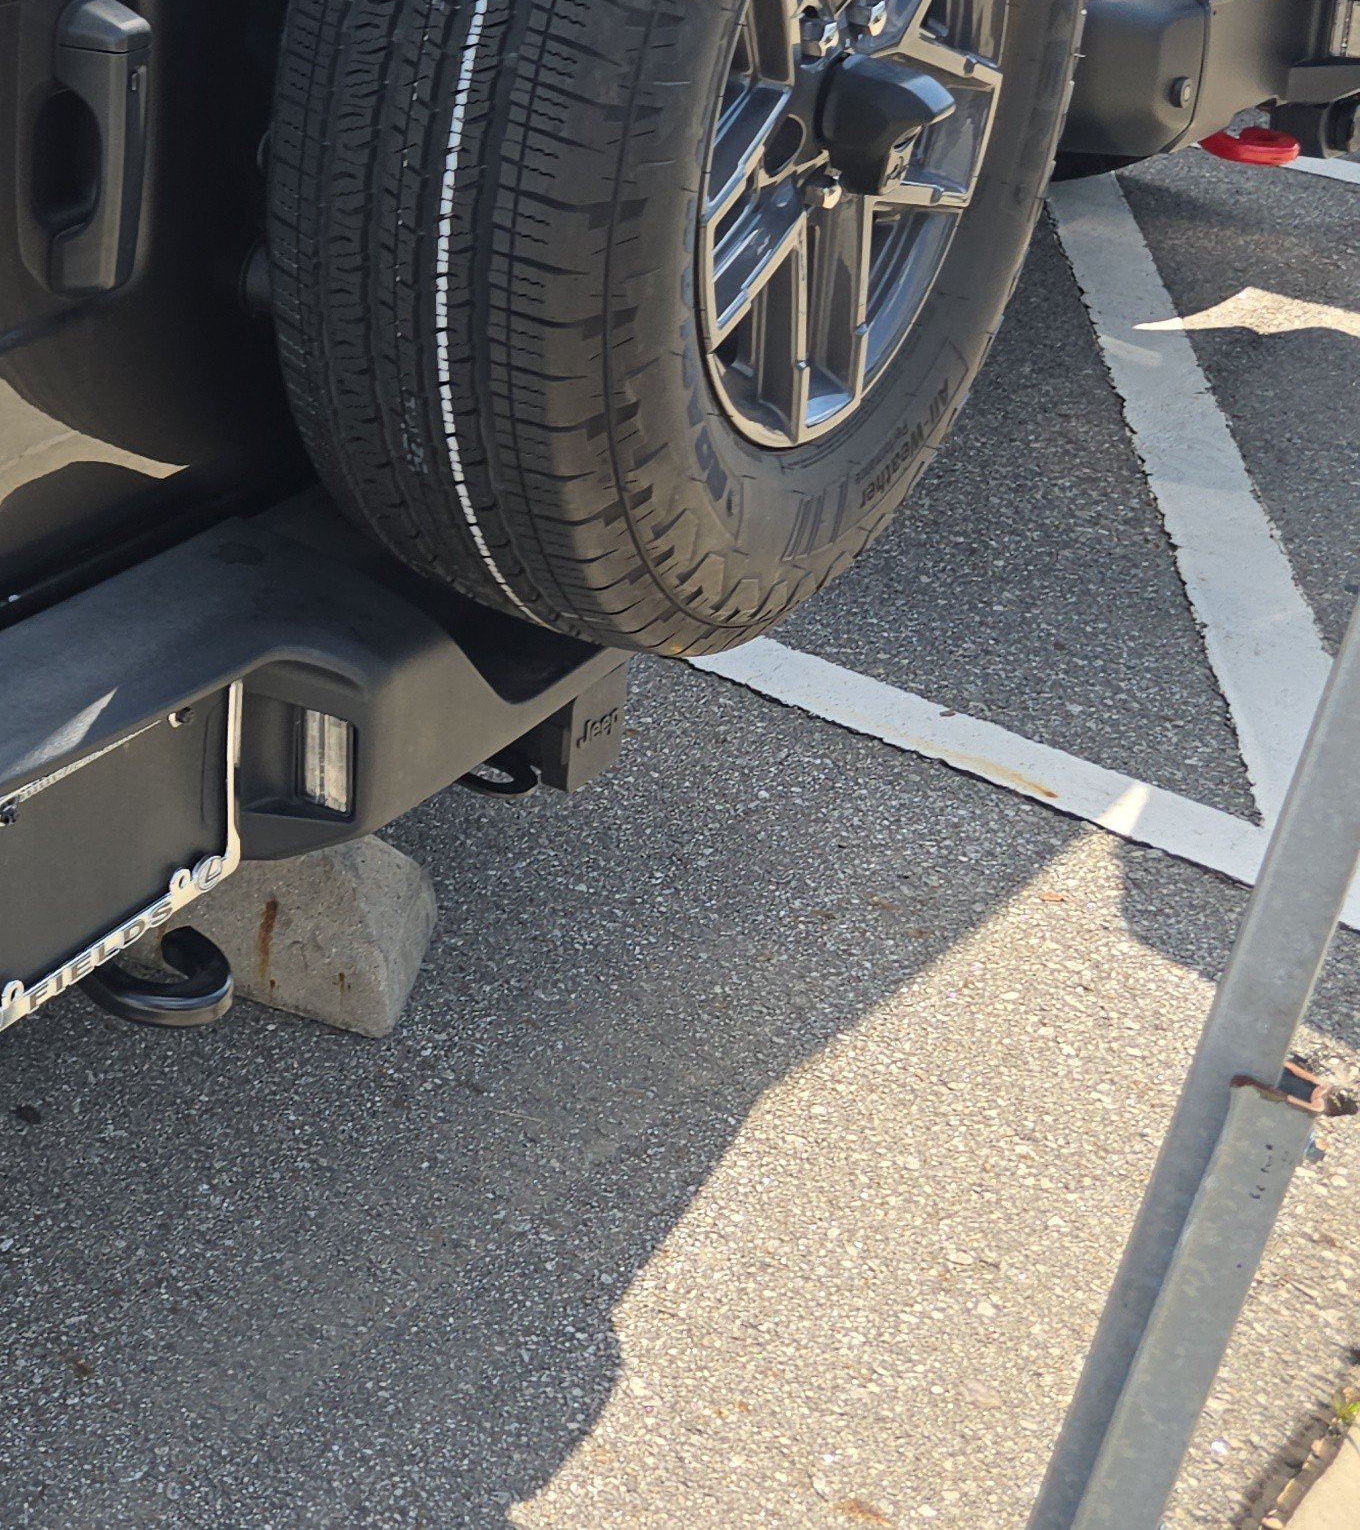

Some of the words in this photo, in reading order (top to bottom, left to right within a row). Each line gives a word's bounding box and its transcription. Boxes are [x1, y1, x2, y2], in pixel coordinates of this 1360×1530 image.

[858, 375, 947, 512] All-Weather
[576, 707, 618, 749] Jeep
[26, 898, 175, 1014] FIELDS
